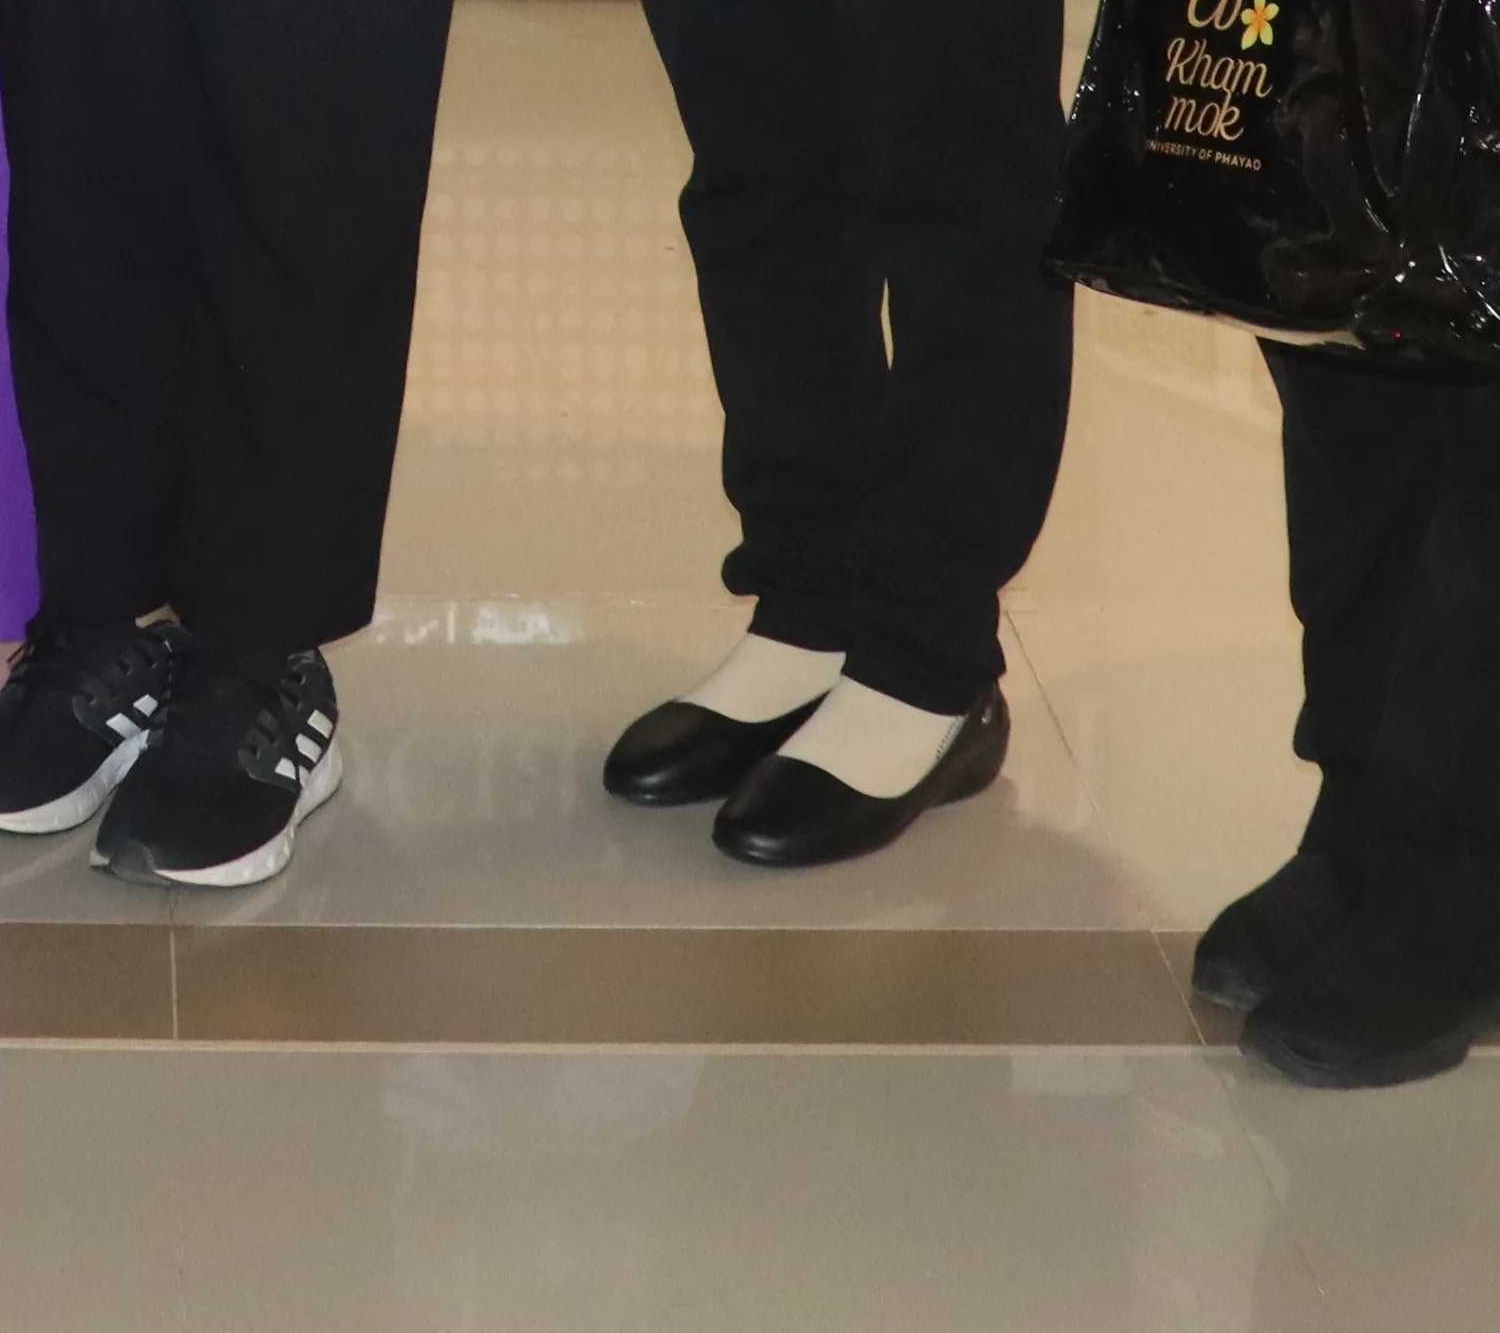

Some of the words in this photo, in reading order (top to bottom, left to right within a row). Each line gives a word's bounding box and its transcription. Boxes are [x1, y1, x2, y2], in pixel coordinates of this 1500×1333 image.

[1165, 37, 1274, 98] Kham
[1164, 89, 1245, 142] mok
[1199, 147, 1212, 161] OF
[1215, 150, 1262, 171] PHAYAO
